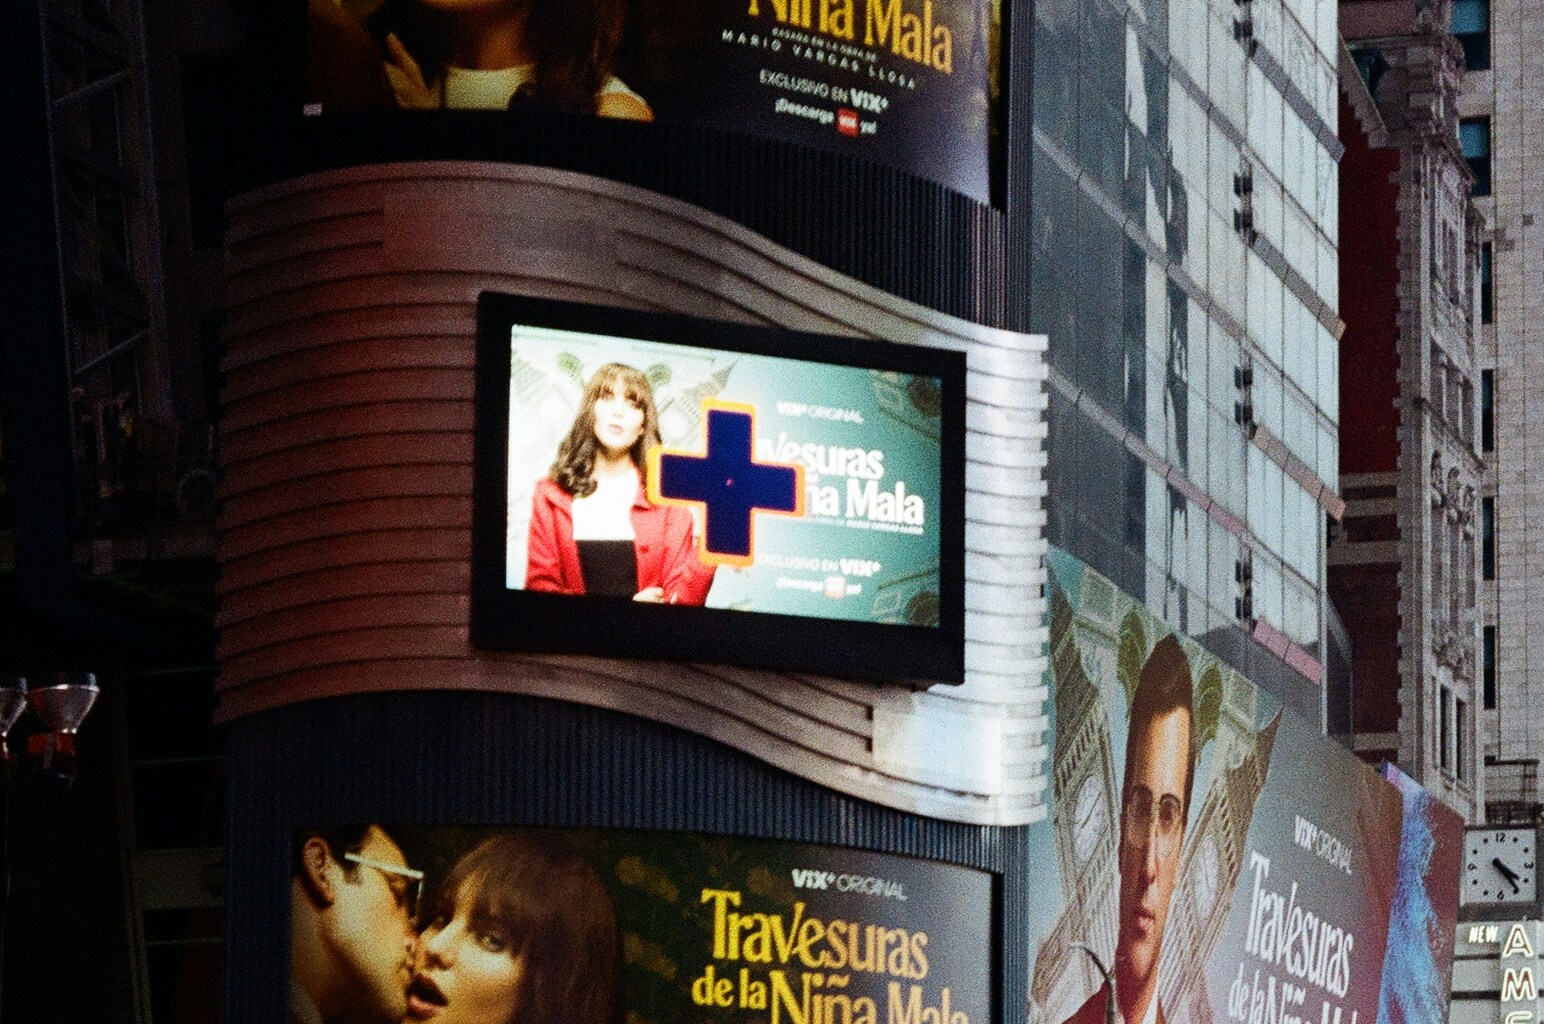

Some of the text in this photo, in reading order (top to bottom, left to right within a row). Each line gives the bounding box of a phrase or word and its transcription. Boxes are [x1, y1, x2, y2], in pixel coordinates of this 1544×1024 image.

[722, 29, 916, 90] MARIO VARGAS LLOSA
[865, 0, 952, 74] Mala
[760, 68, 829, 98] EXCLUSIVO
[846, 478, 924, 526] Mala
[1494, 832, 1507, 844] 12
[836, 876, 908, 901] ORIGINAL
[701, 888, 929, 980] Travesuras
[1244, 850, 1354, 999] Travesuras
[1468, 926, 1498, 944] NEW
[691, 965, 734, 1007] de
[738, 968, 767, 1010] la
[1228, 962, 1249, 1021] de
